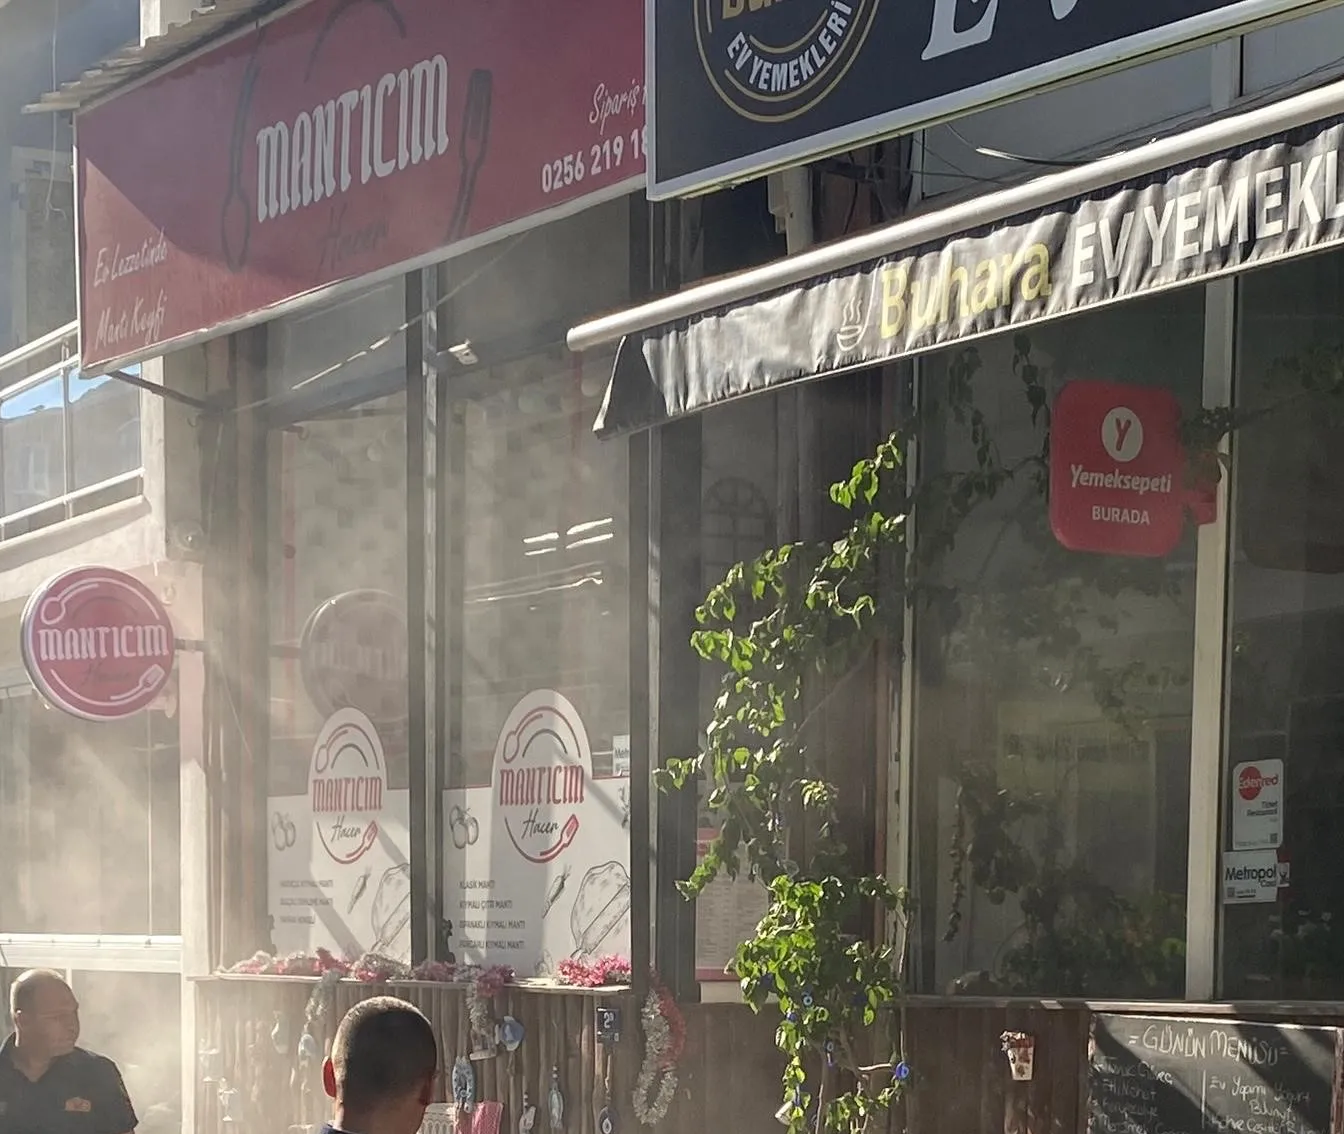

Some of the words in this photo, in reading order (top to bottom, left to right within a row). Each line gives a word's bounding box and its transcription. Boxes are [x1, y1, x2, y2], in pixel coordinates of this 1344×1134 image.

[727, 31, 753, 71] EV
[748, 0, 853, 92] YEMEKLERİ
[256, 53, 449, 224] MANTICIM
[541, 150, 585, 193] 0256
[590, 135, 624, 176] 219
[878, 241, 1052, 341] Buhara
[1071, 211, 1135, 288] EV
[1070, 463, 1172, 495] Yemeksepeti
[1091, 505, 1151, 525] BURADA
[37, 624, 170, 661] MANTICIM
[312, 776, 383, 812] MANTICIM
[499, 764, 585, 806] MANTICIM
[1224, 864, 1277, 882] Metropol
